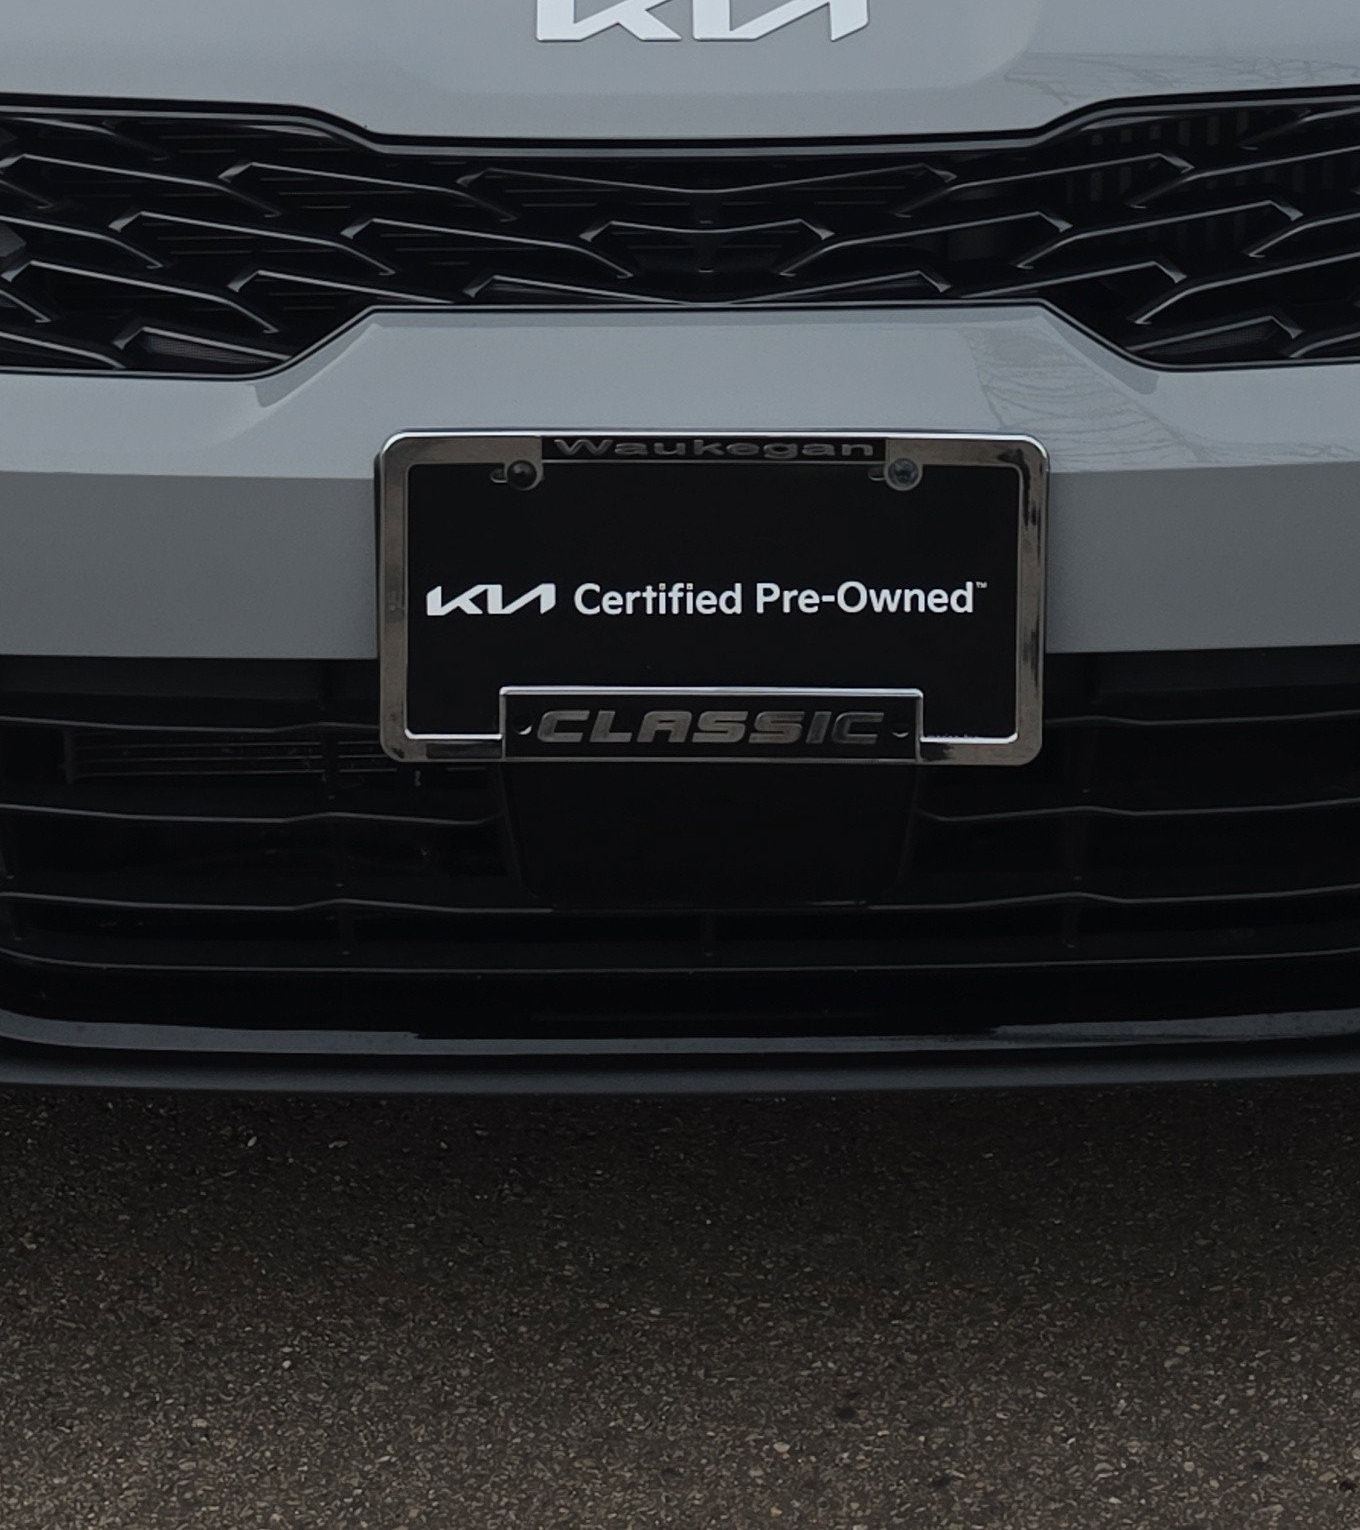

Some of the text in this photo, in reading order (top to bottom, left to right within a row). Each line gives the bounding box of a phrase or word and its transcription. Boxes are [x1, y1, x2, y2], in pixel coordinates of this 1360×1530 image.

[554, 438, 874, 459] Waukegan
[426, 583, 556, 616] KIA
[574, 582, 742, 615] Certified
[537, 710, 885, 744] CLASSIC
